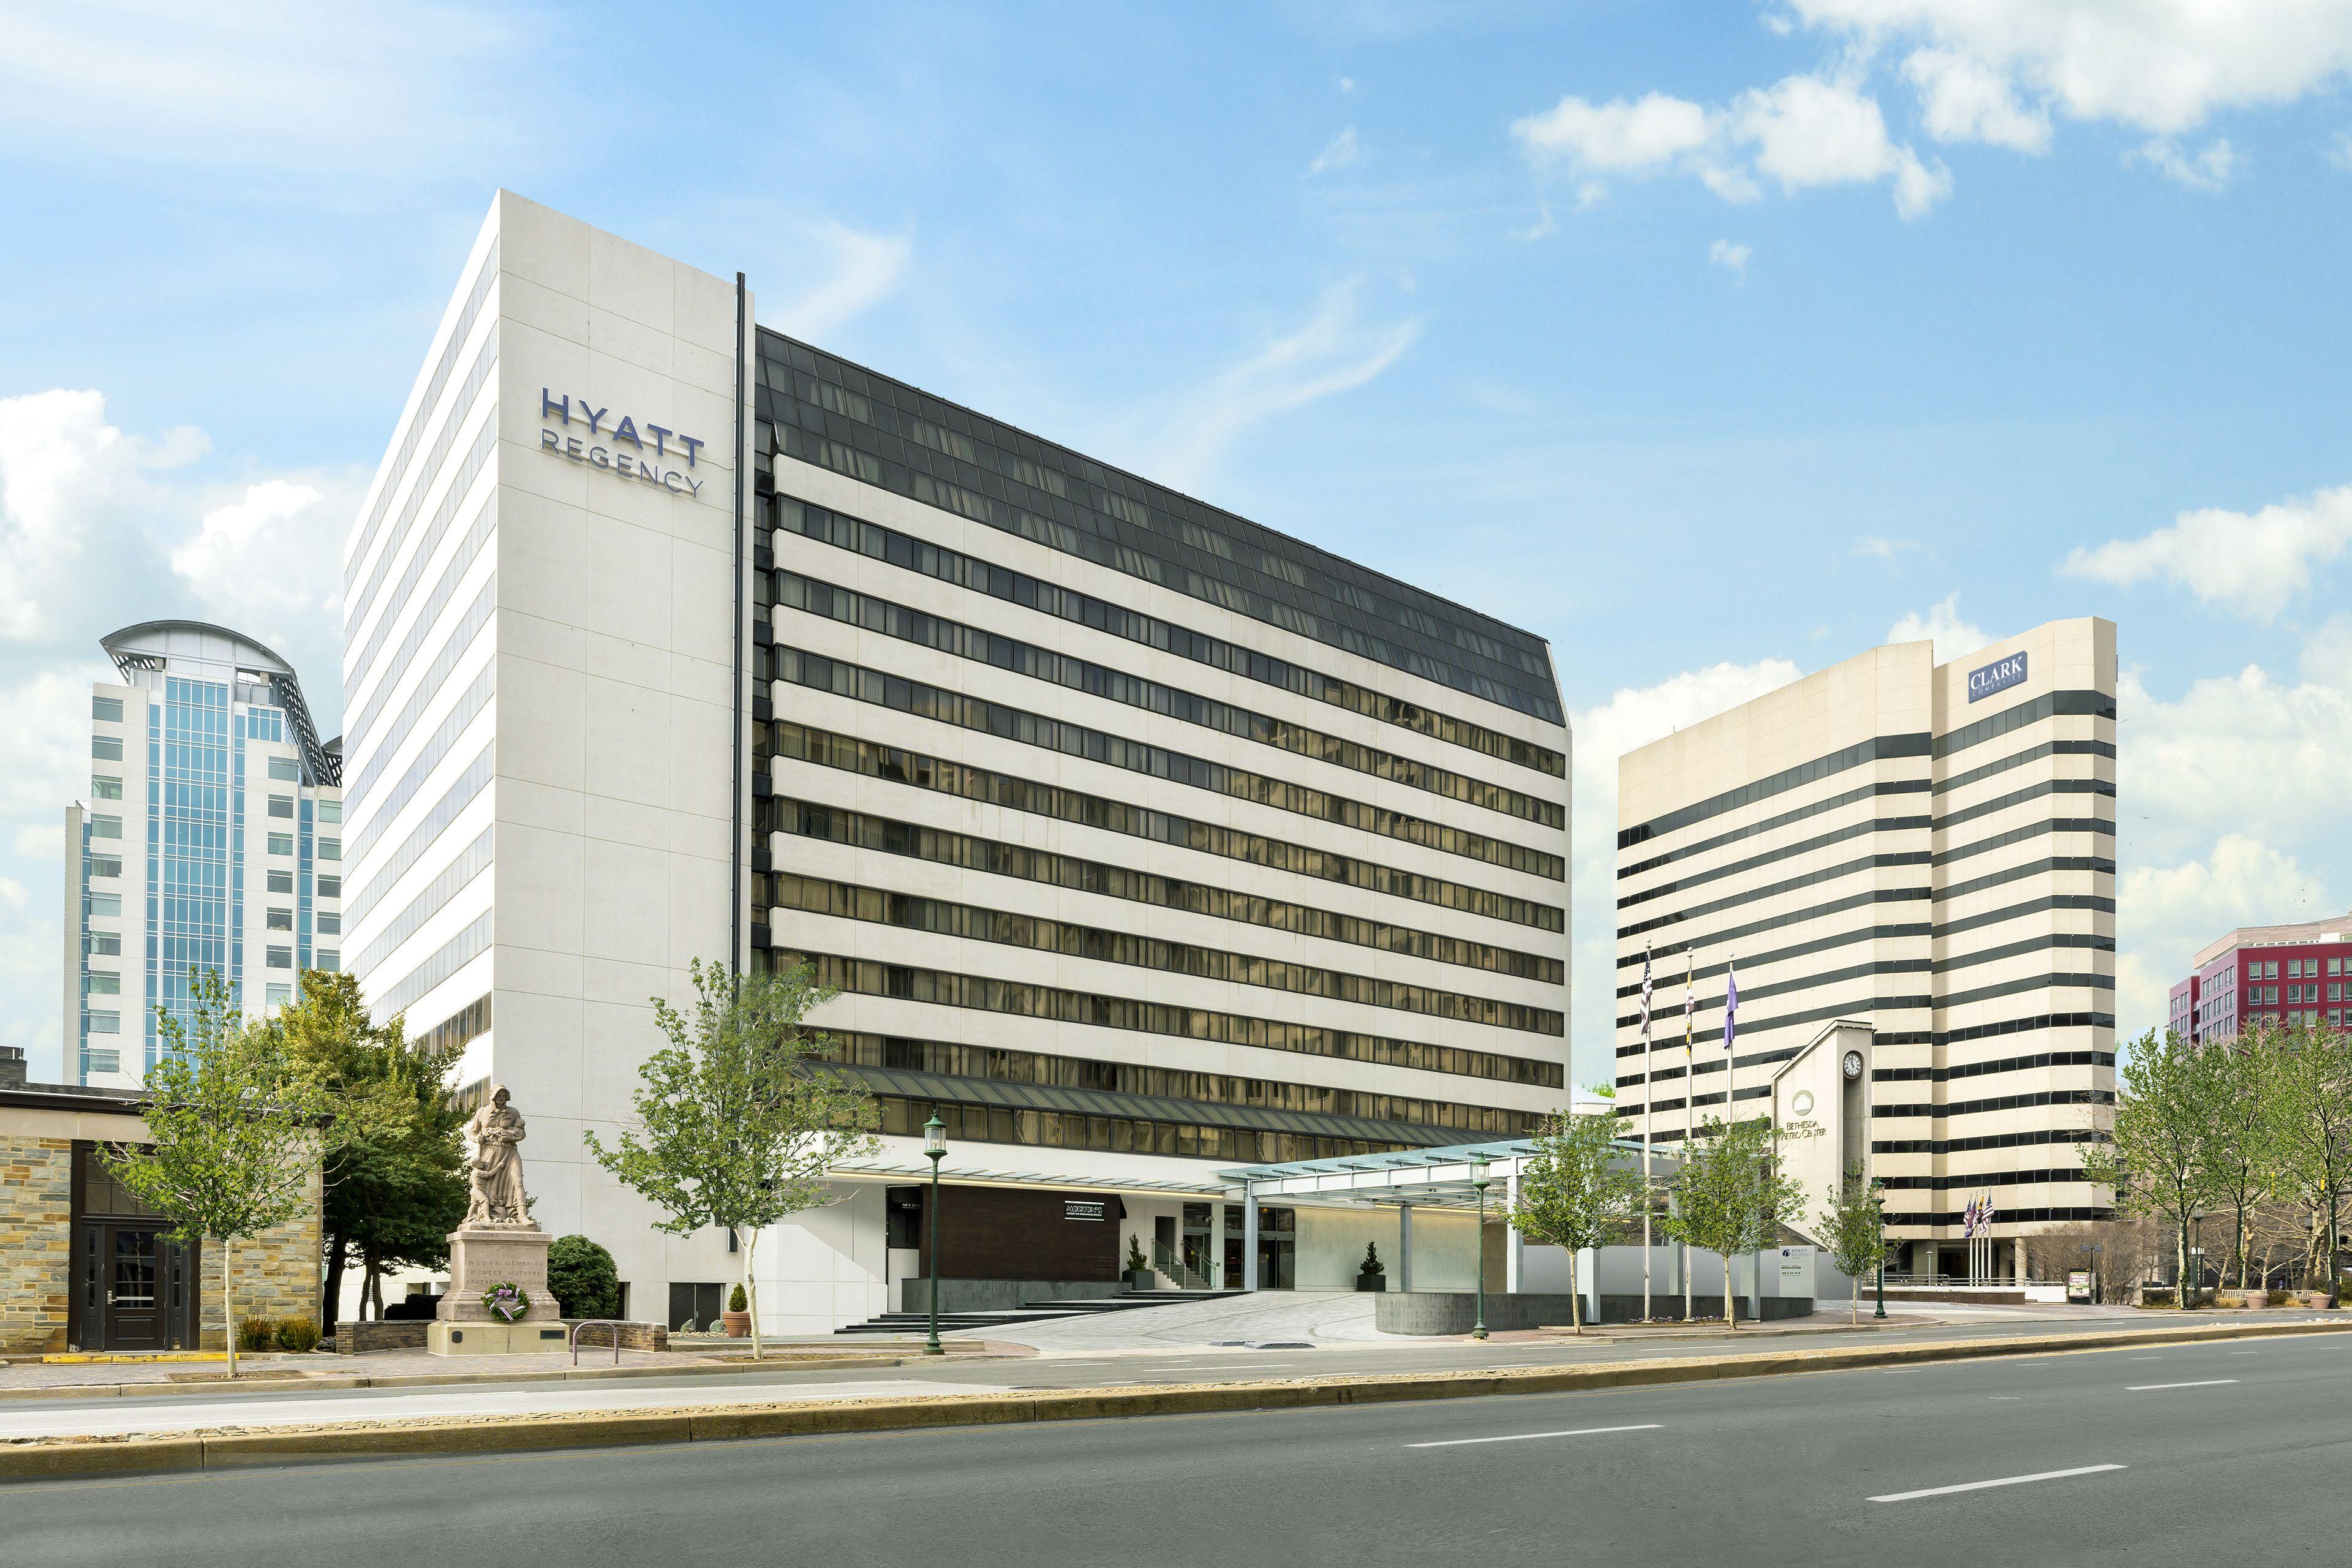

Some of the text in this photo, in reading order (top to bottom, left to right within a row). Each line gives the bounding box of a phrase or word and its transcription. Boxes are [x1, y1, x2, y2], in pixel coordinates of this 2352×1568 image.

[541, 387, 704, 468] HYATT
[541, 428, 703, 498] REGENCY
[1970, 656, 2022, 690] CLARK
[1972, 674, 2021, 696] COMPANIES
[1778, 1128, 1826, 1140] METRO CENTER
[1786, 1120, 1819, 1131] BETHESDA
[1066, 1205, 1102, 1213] MORTON'S
